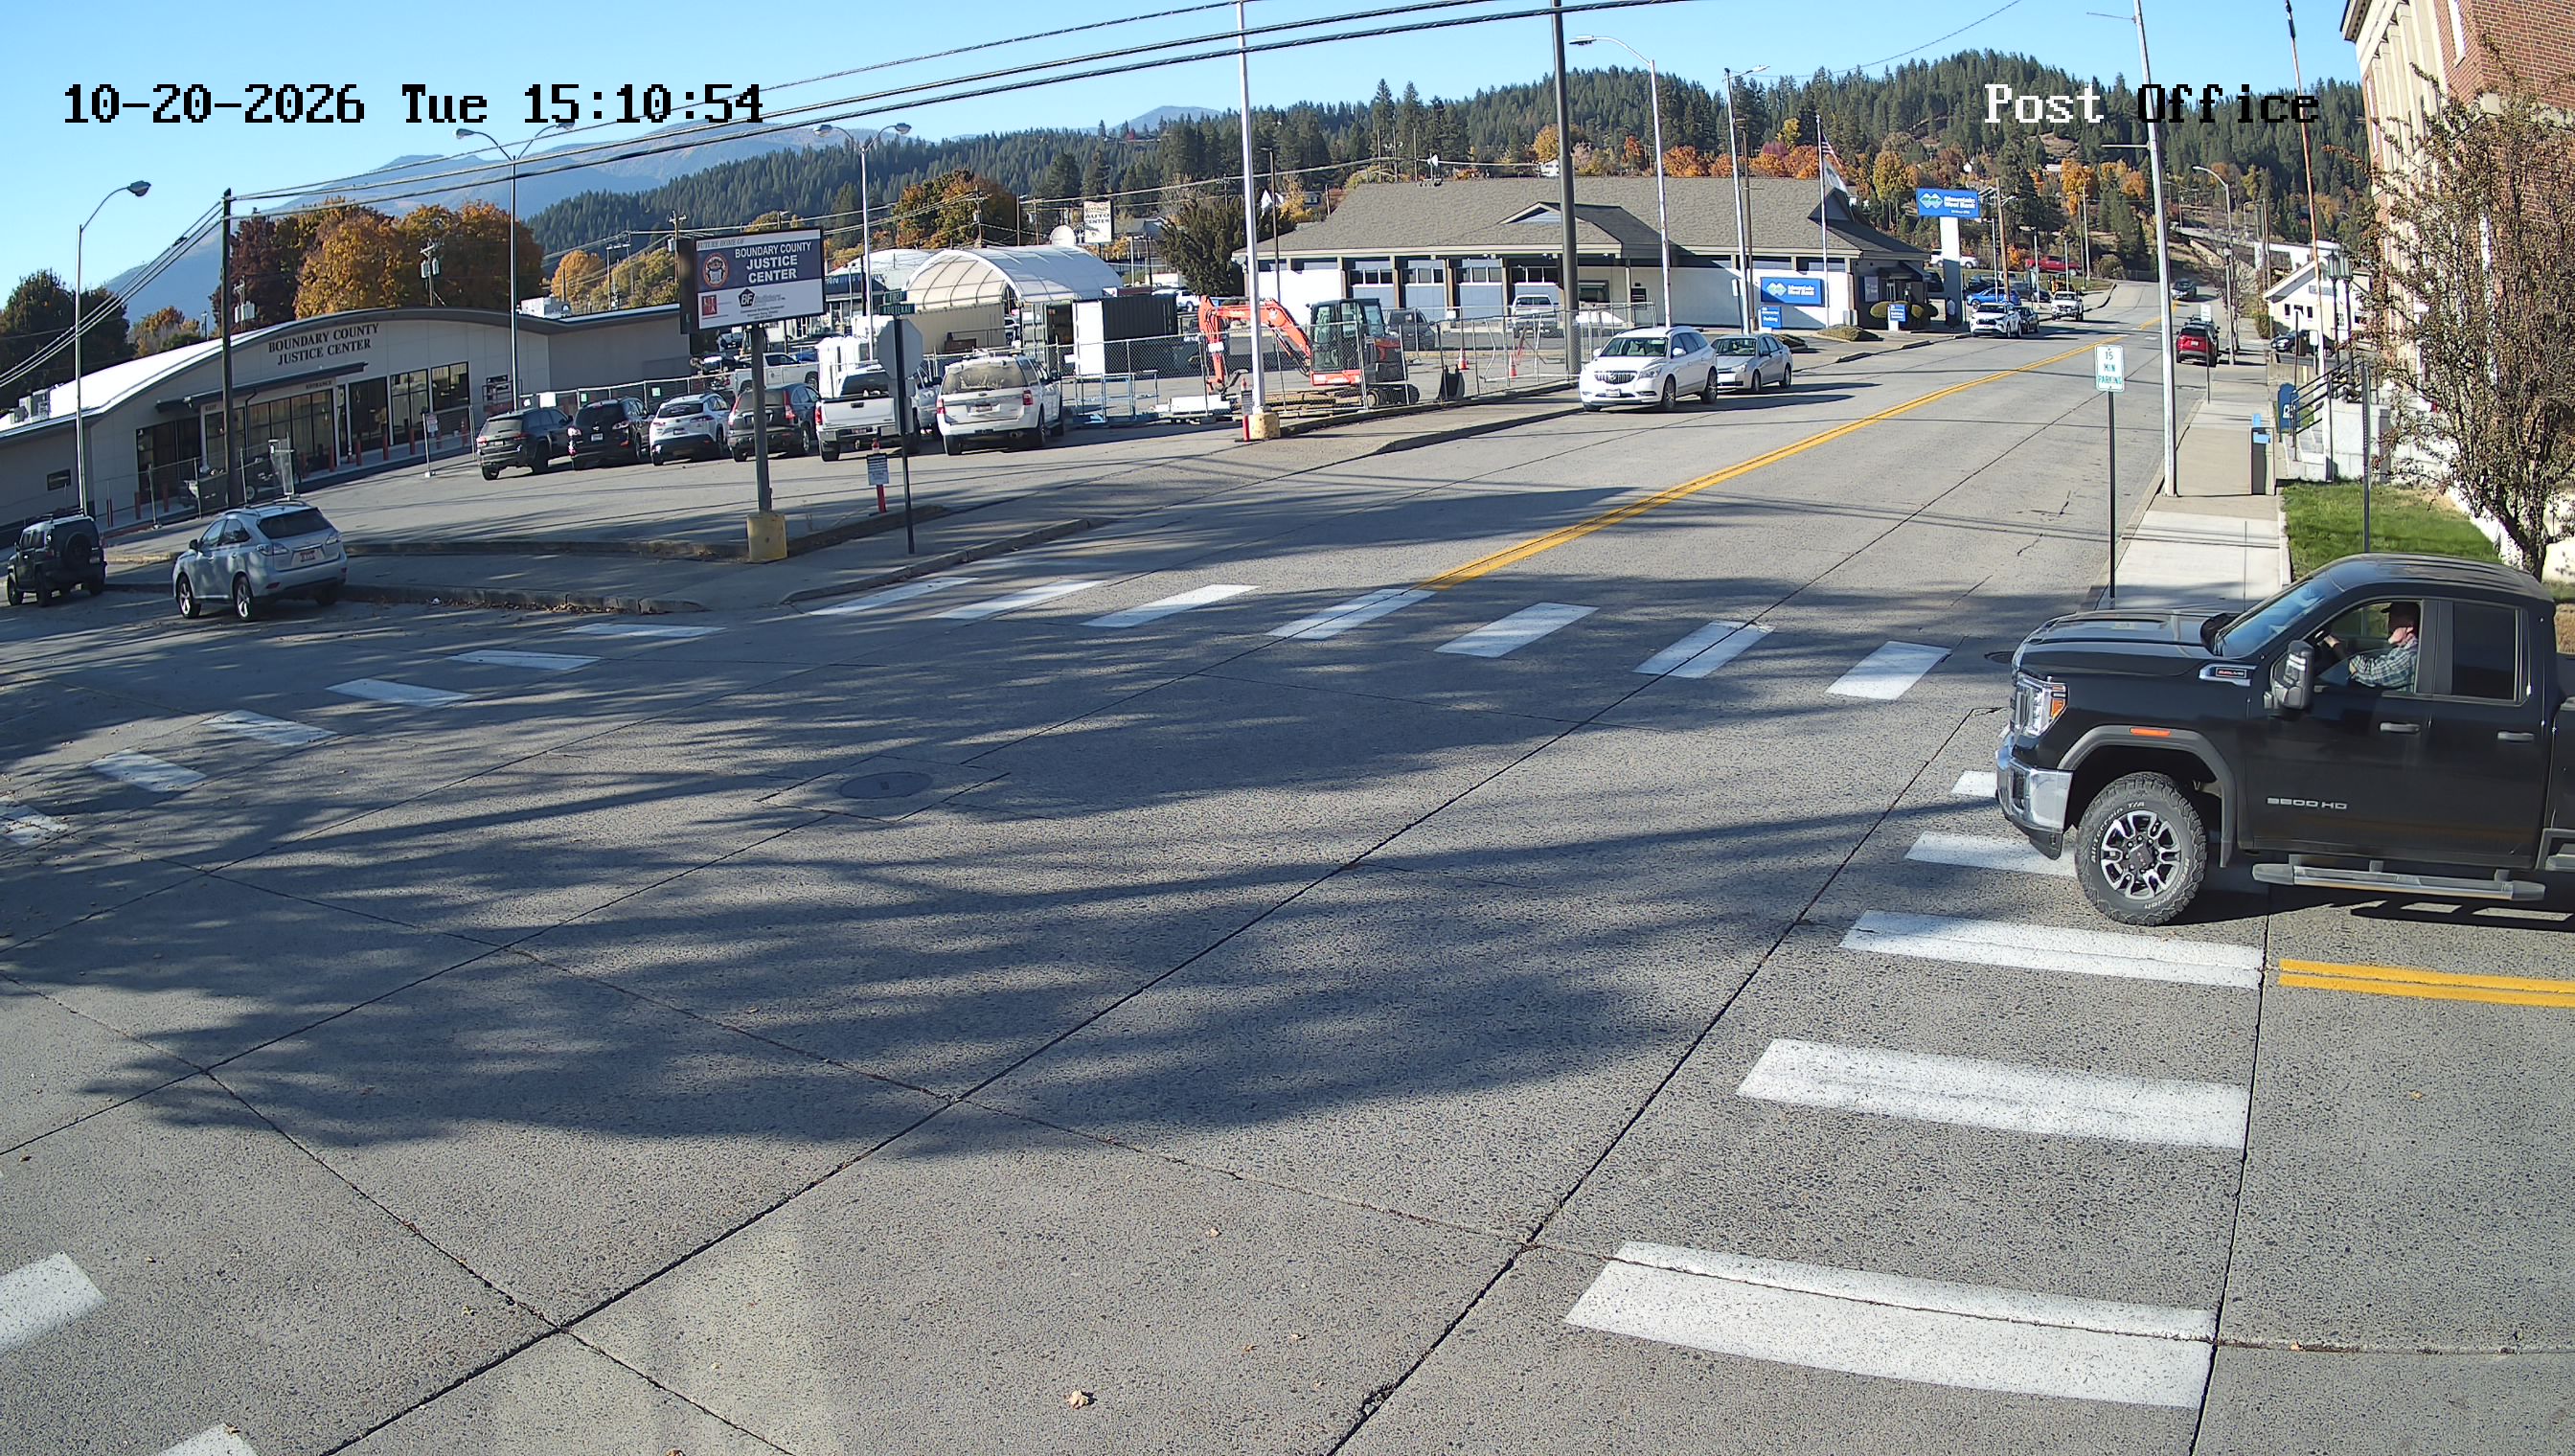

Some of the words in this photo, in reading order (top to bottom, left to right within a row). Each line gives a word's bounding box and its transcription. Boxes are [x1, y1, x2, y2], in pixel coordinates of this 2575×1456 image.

[735, 244, 779, 259] BOUNDARY
[780, 241, 812, 254] COUNTY
[746, 255, 798, 270] JUSTICE
[748, 268, 797, 284] CENTER
[268, 332, 330, 353] BOUNDARY
[333, 323, 379, 341] COUNTY
[278, 347, 324, 366] JUSTICE
[327, 338, 372, 356] CENTER
[2105, 351, 2114, 360] 15
[2103, 363, 2116, 373] MIN
[2098, 375, 2122, 384] PARKING
[2321, 801, 2347, 810] HD
